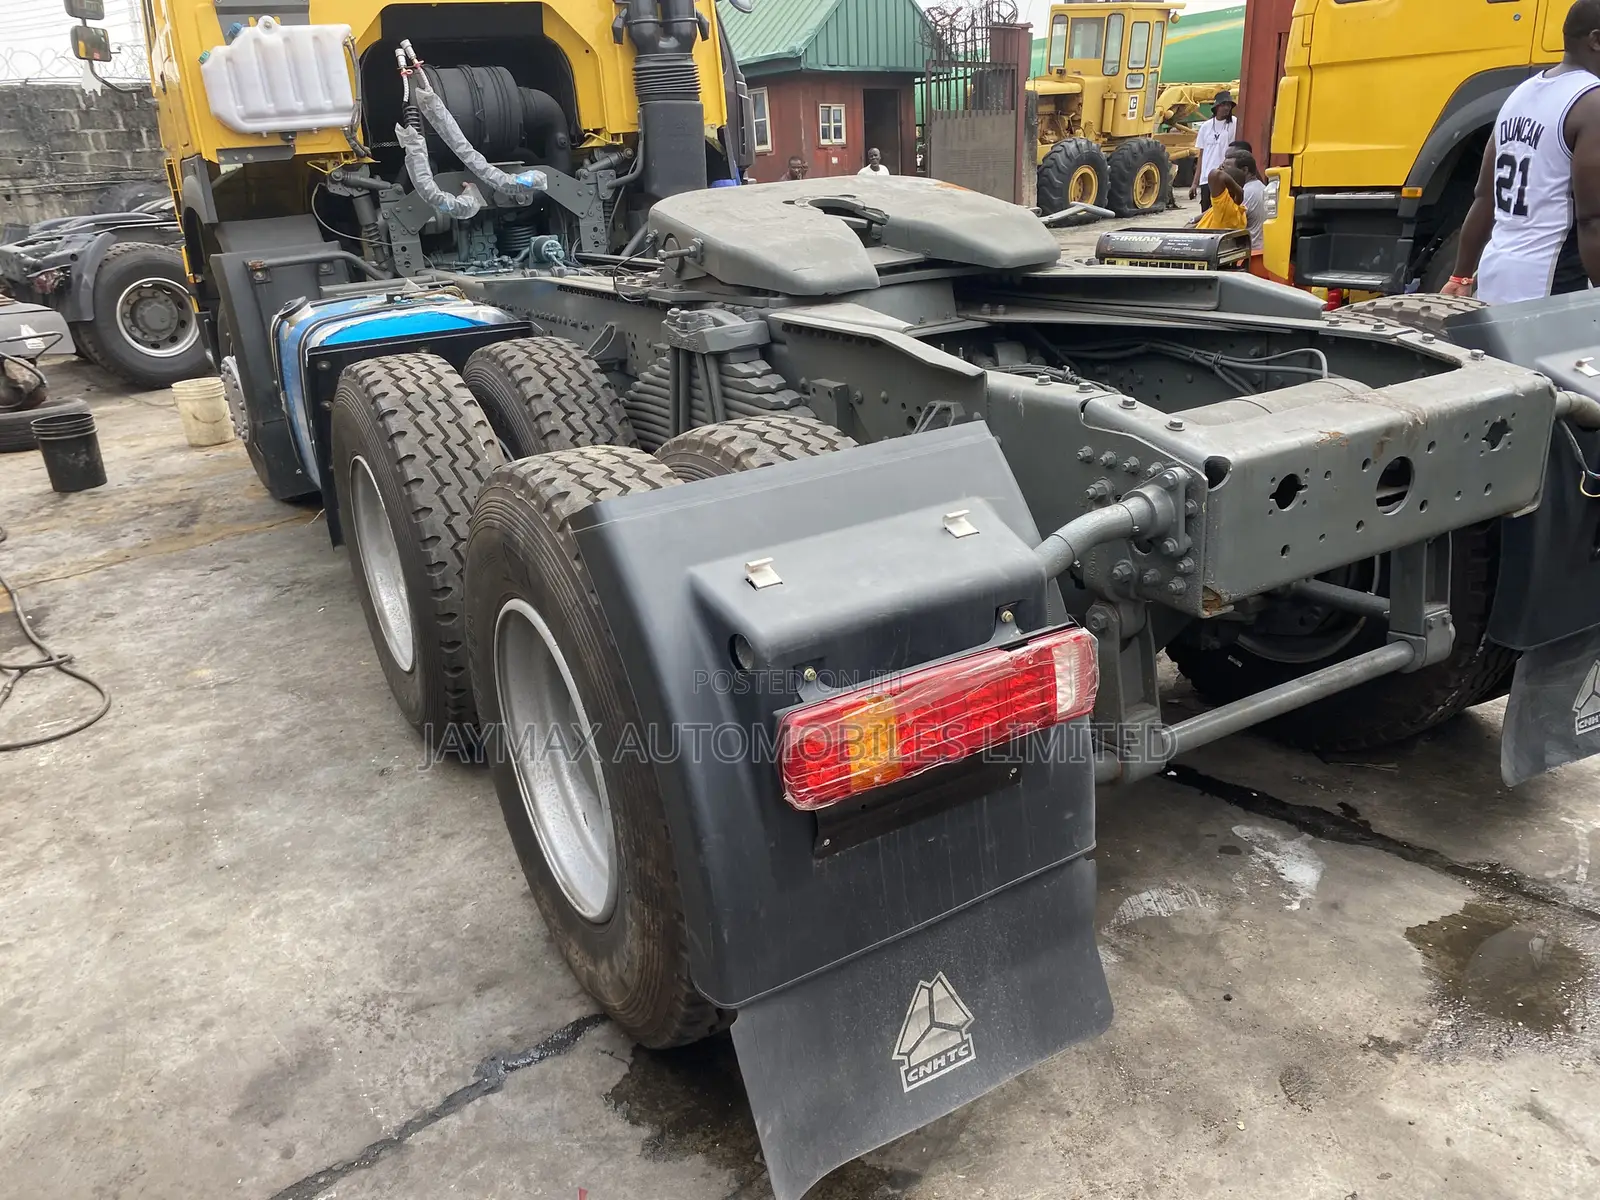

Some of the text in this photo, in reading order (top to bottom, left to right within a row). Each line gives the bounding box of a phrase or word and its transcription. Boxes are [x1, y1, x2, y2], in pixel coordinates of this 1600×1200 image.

[1500, 116, 1545, 150] DUNCAN
[1496, 153, 1531, 216] 21
[1578, 714, 1600, 729] CNH
[907, 1043, 969, 1082] CNHTC
